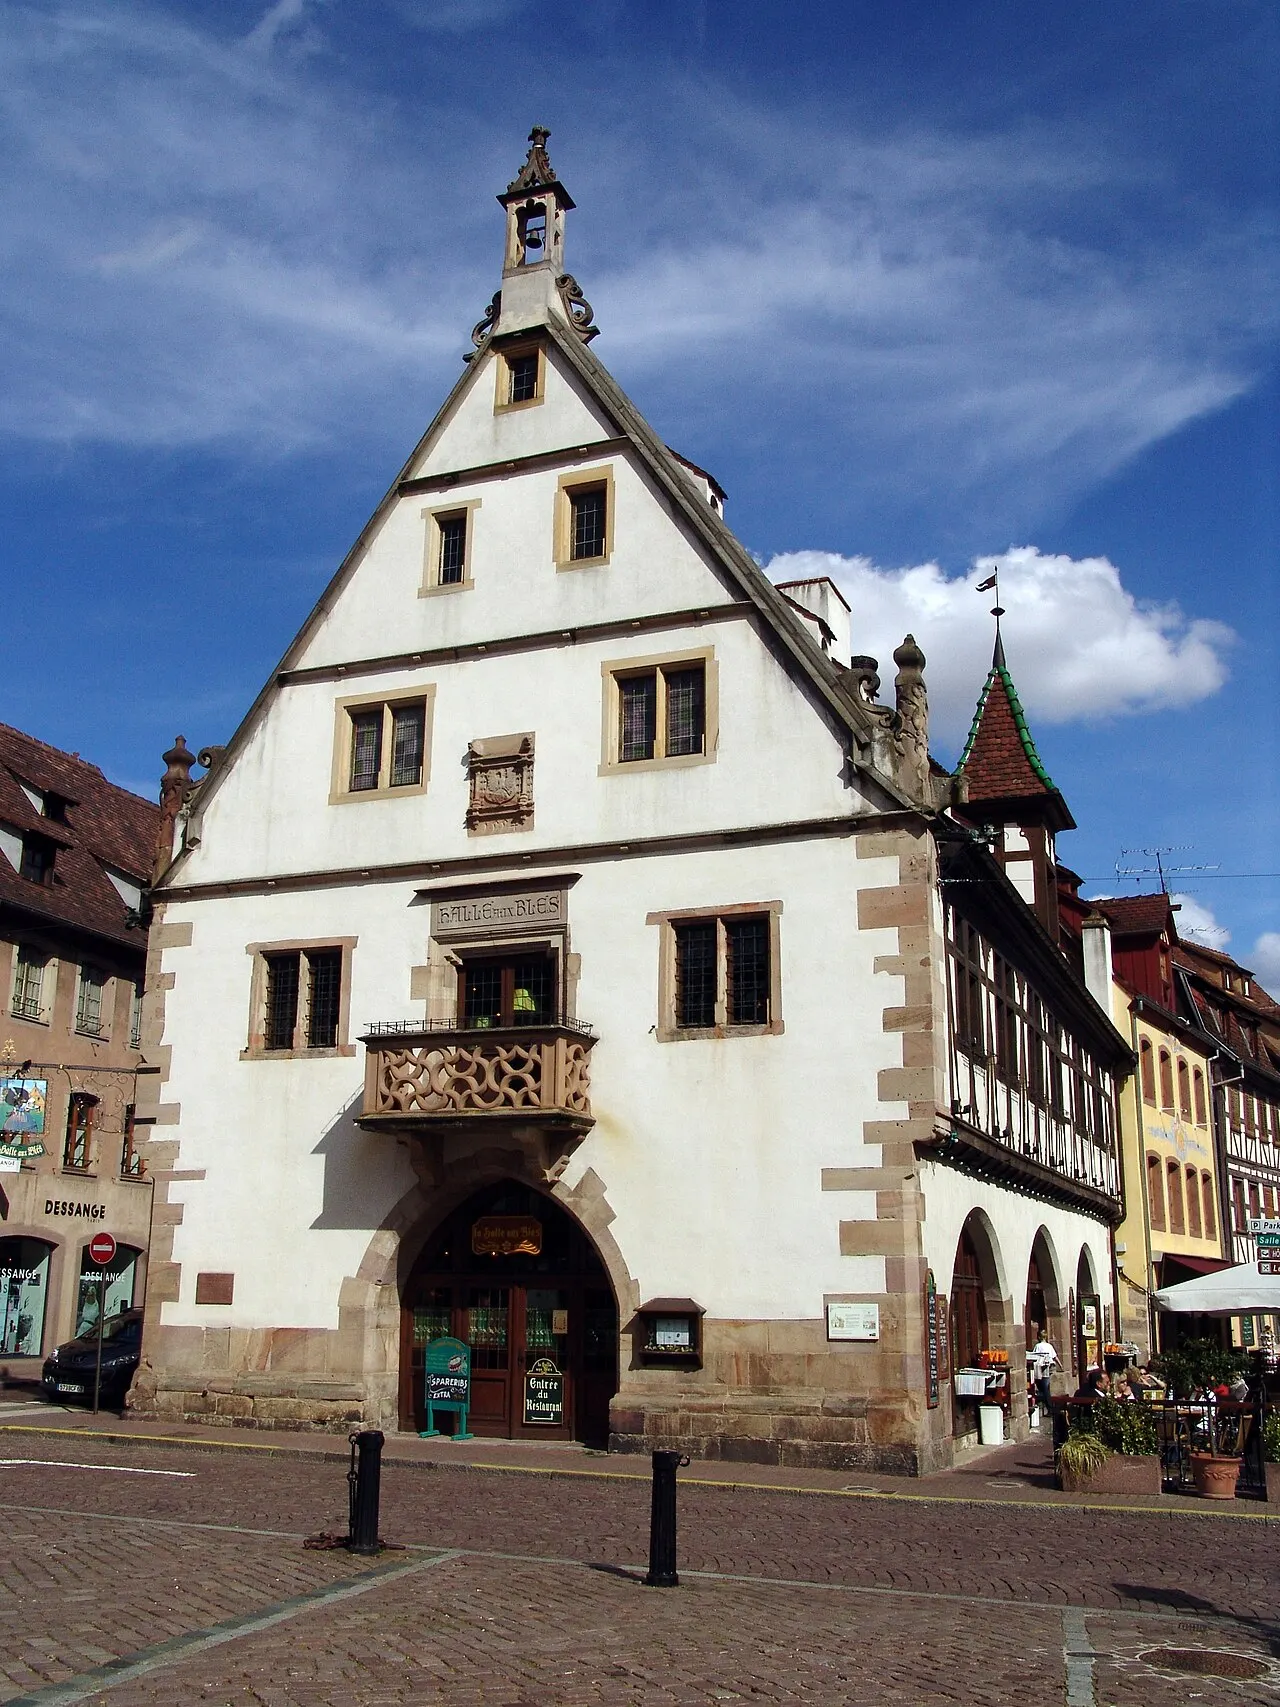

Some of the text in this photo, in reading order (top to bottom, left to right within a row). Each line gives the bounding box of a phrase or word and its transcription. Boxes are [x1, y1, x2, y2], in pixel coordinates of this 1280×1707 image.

[45, 1199, 106, 1220] DESSANGE
[1259, 1236, 1280, 1245] Salle
[0, 1268, 37, 1280] SSANGE
[431, 1377, 468, 1390] SPARERIBS
[530, 1377, 559, 1390] Entrée
[433, 1391, 451, 1399] EXTRA
[537, 1389, 549, 1399] du
